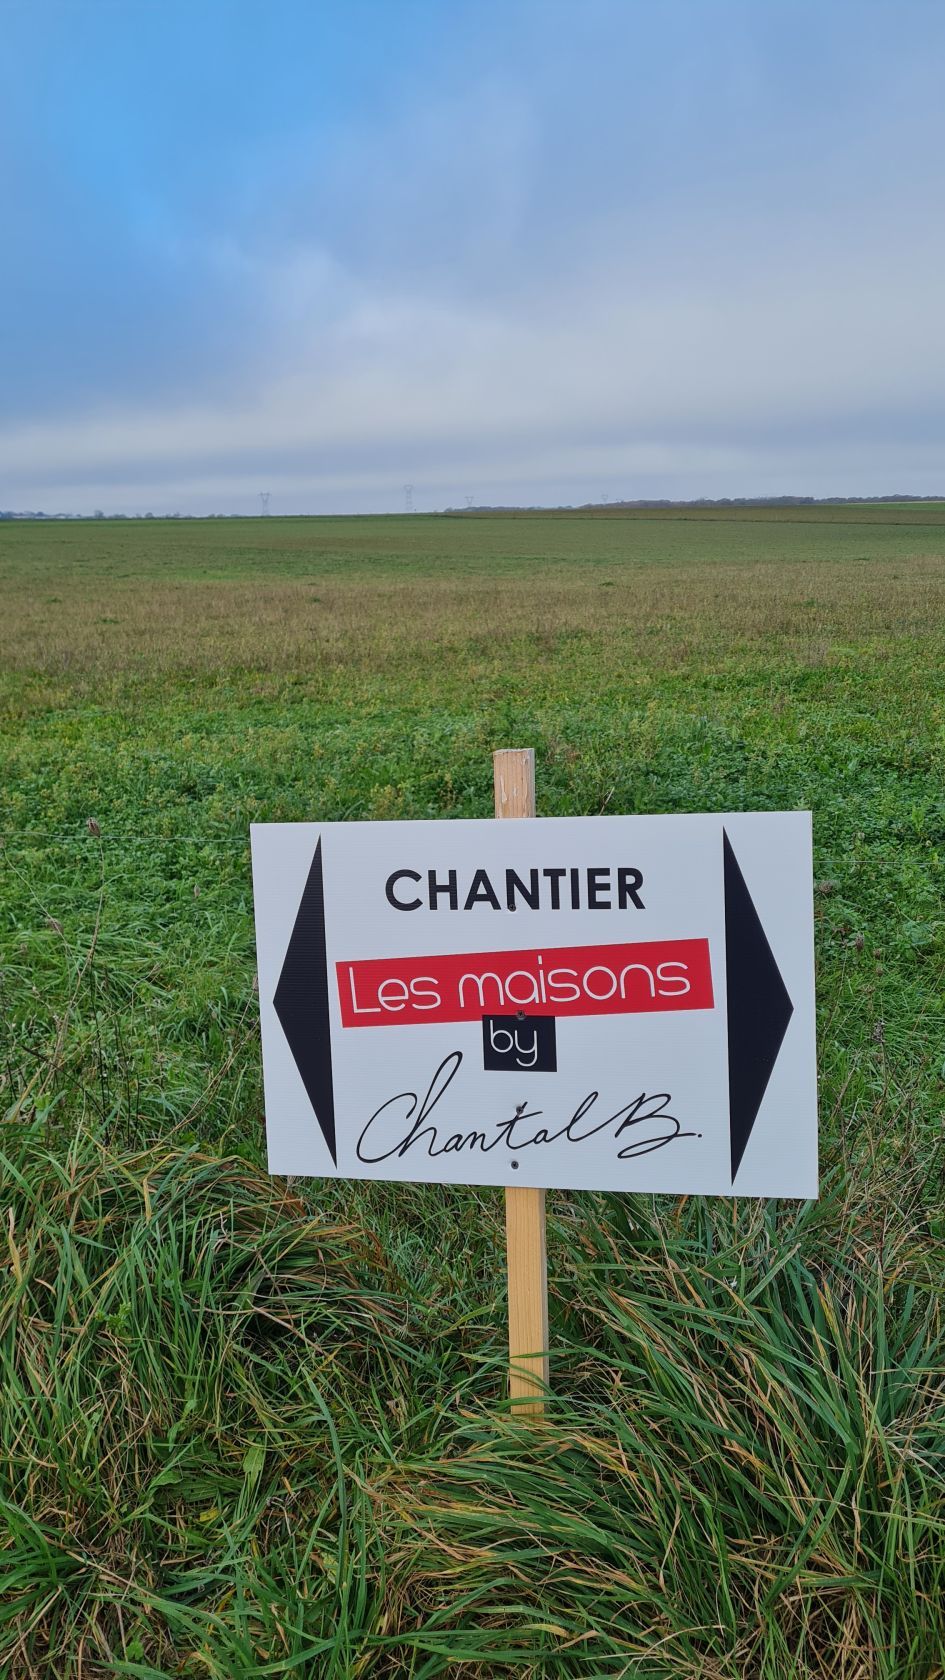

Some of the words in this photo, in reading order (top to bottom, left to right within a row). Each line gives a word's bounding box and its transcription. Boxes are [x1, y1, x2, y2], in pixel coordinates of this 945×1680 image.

[385, 867, 646, 911] CHANTIER
[349, 966, 440, 1015] Les
[458, 955, 691, 1008] maisons
[489, 1019, 538, 1067] by
[356, 1051, 606, 1164] Chantal
[609, 1092, 703, 1160] B.
